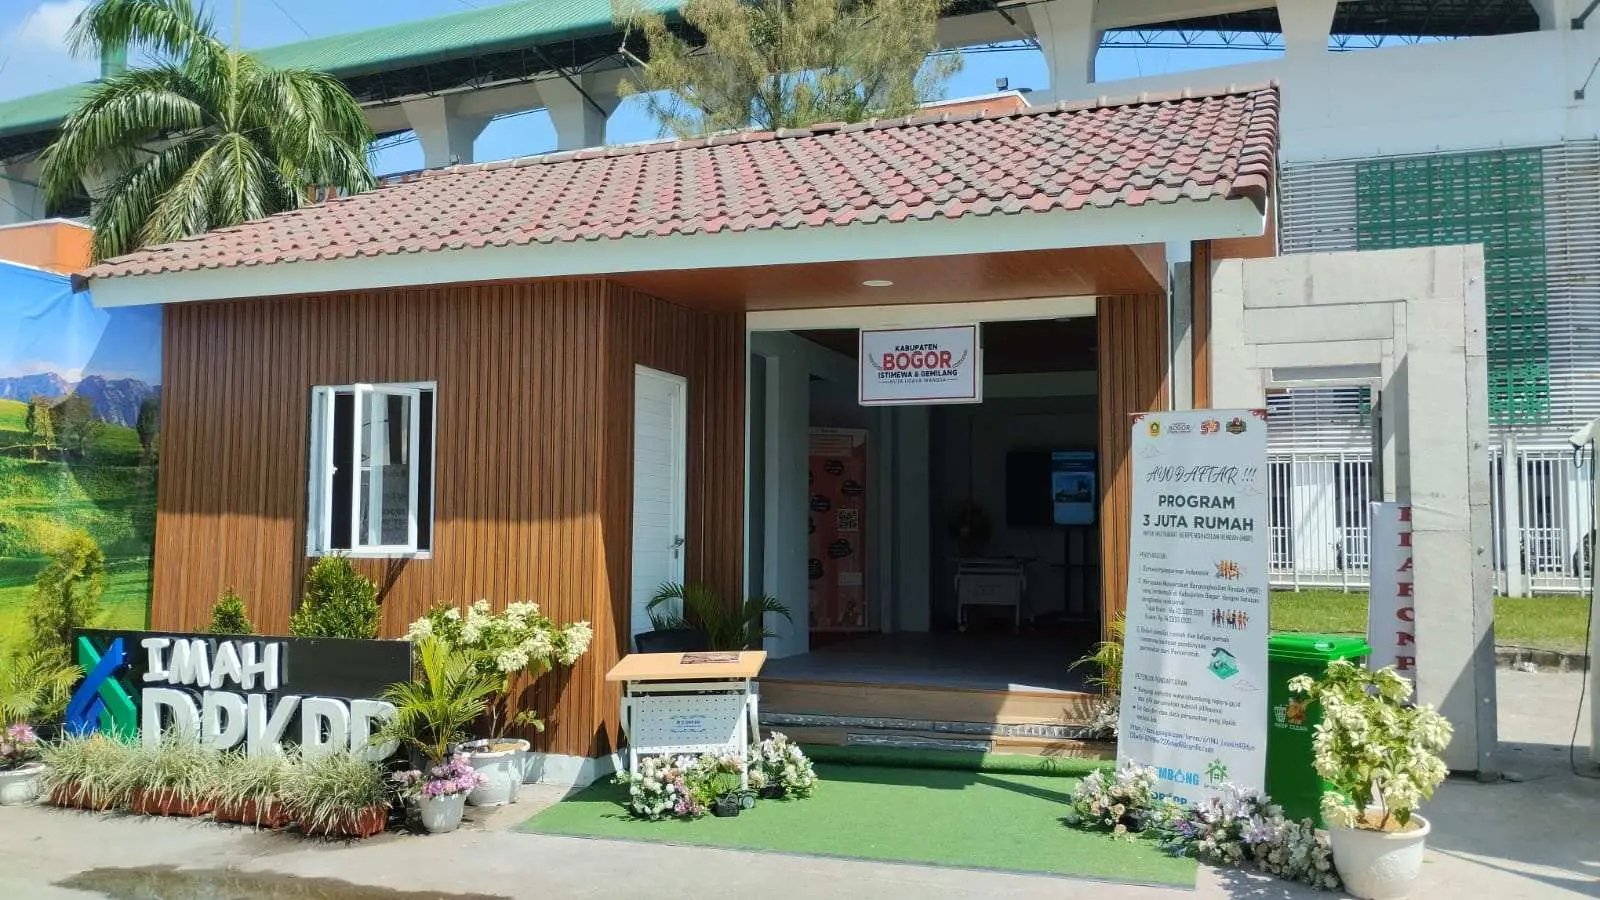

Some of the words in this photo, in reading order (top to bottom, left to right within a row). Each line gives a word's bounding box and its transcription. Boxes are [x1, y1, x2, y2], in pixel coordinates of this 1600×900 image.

[895, 343, 938, 352] KABUPATEN
[883, 351, 952, 371] BOGOR
[878, 371, 913, 379] ISTIMEWA
[920, 369, 958, 377] GEMILANG
[1174, 464, 1238, 485] DAFTAR
[1158, 494, 1235, 509] PROGRAM
[1143, 514, 1150, 526] 3
[1154, 514, 1188, 528] JUTA
[1194, 515, 1254, 531] RUMAH
[141, 637, 279, 690] IMAH
